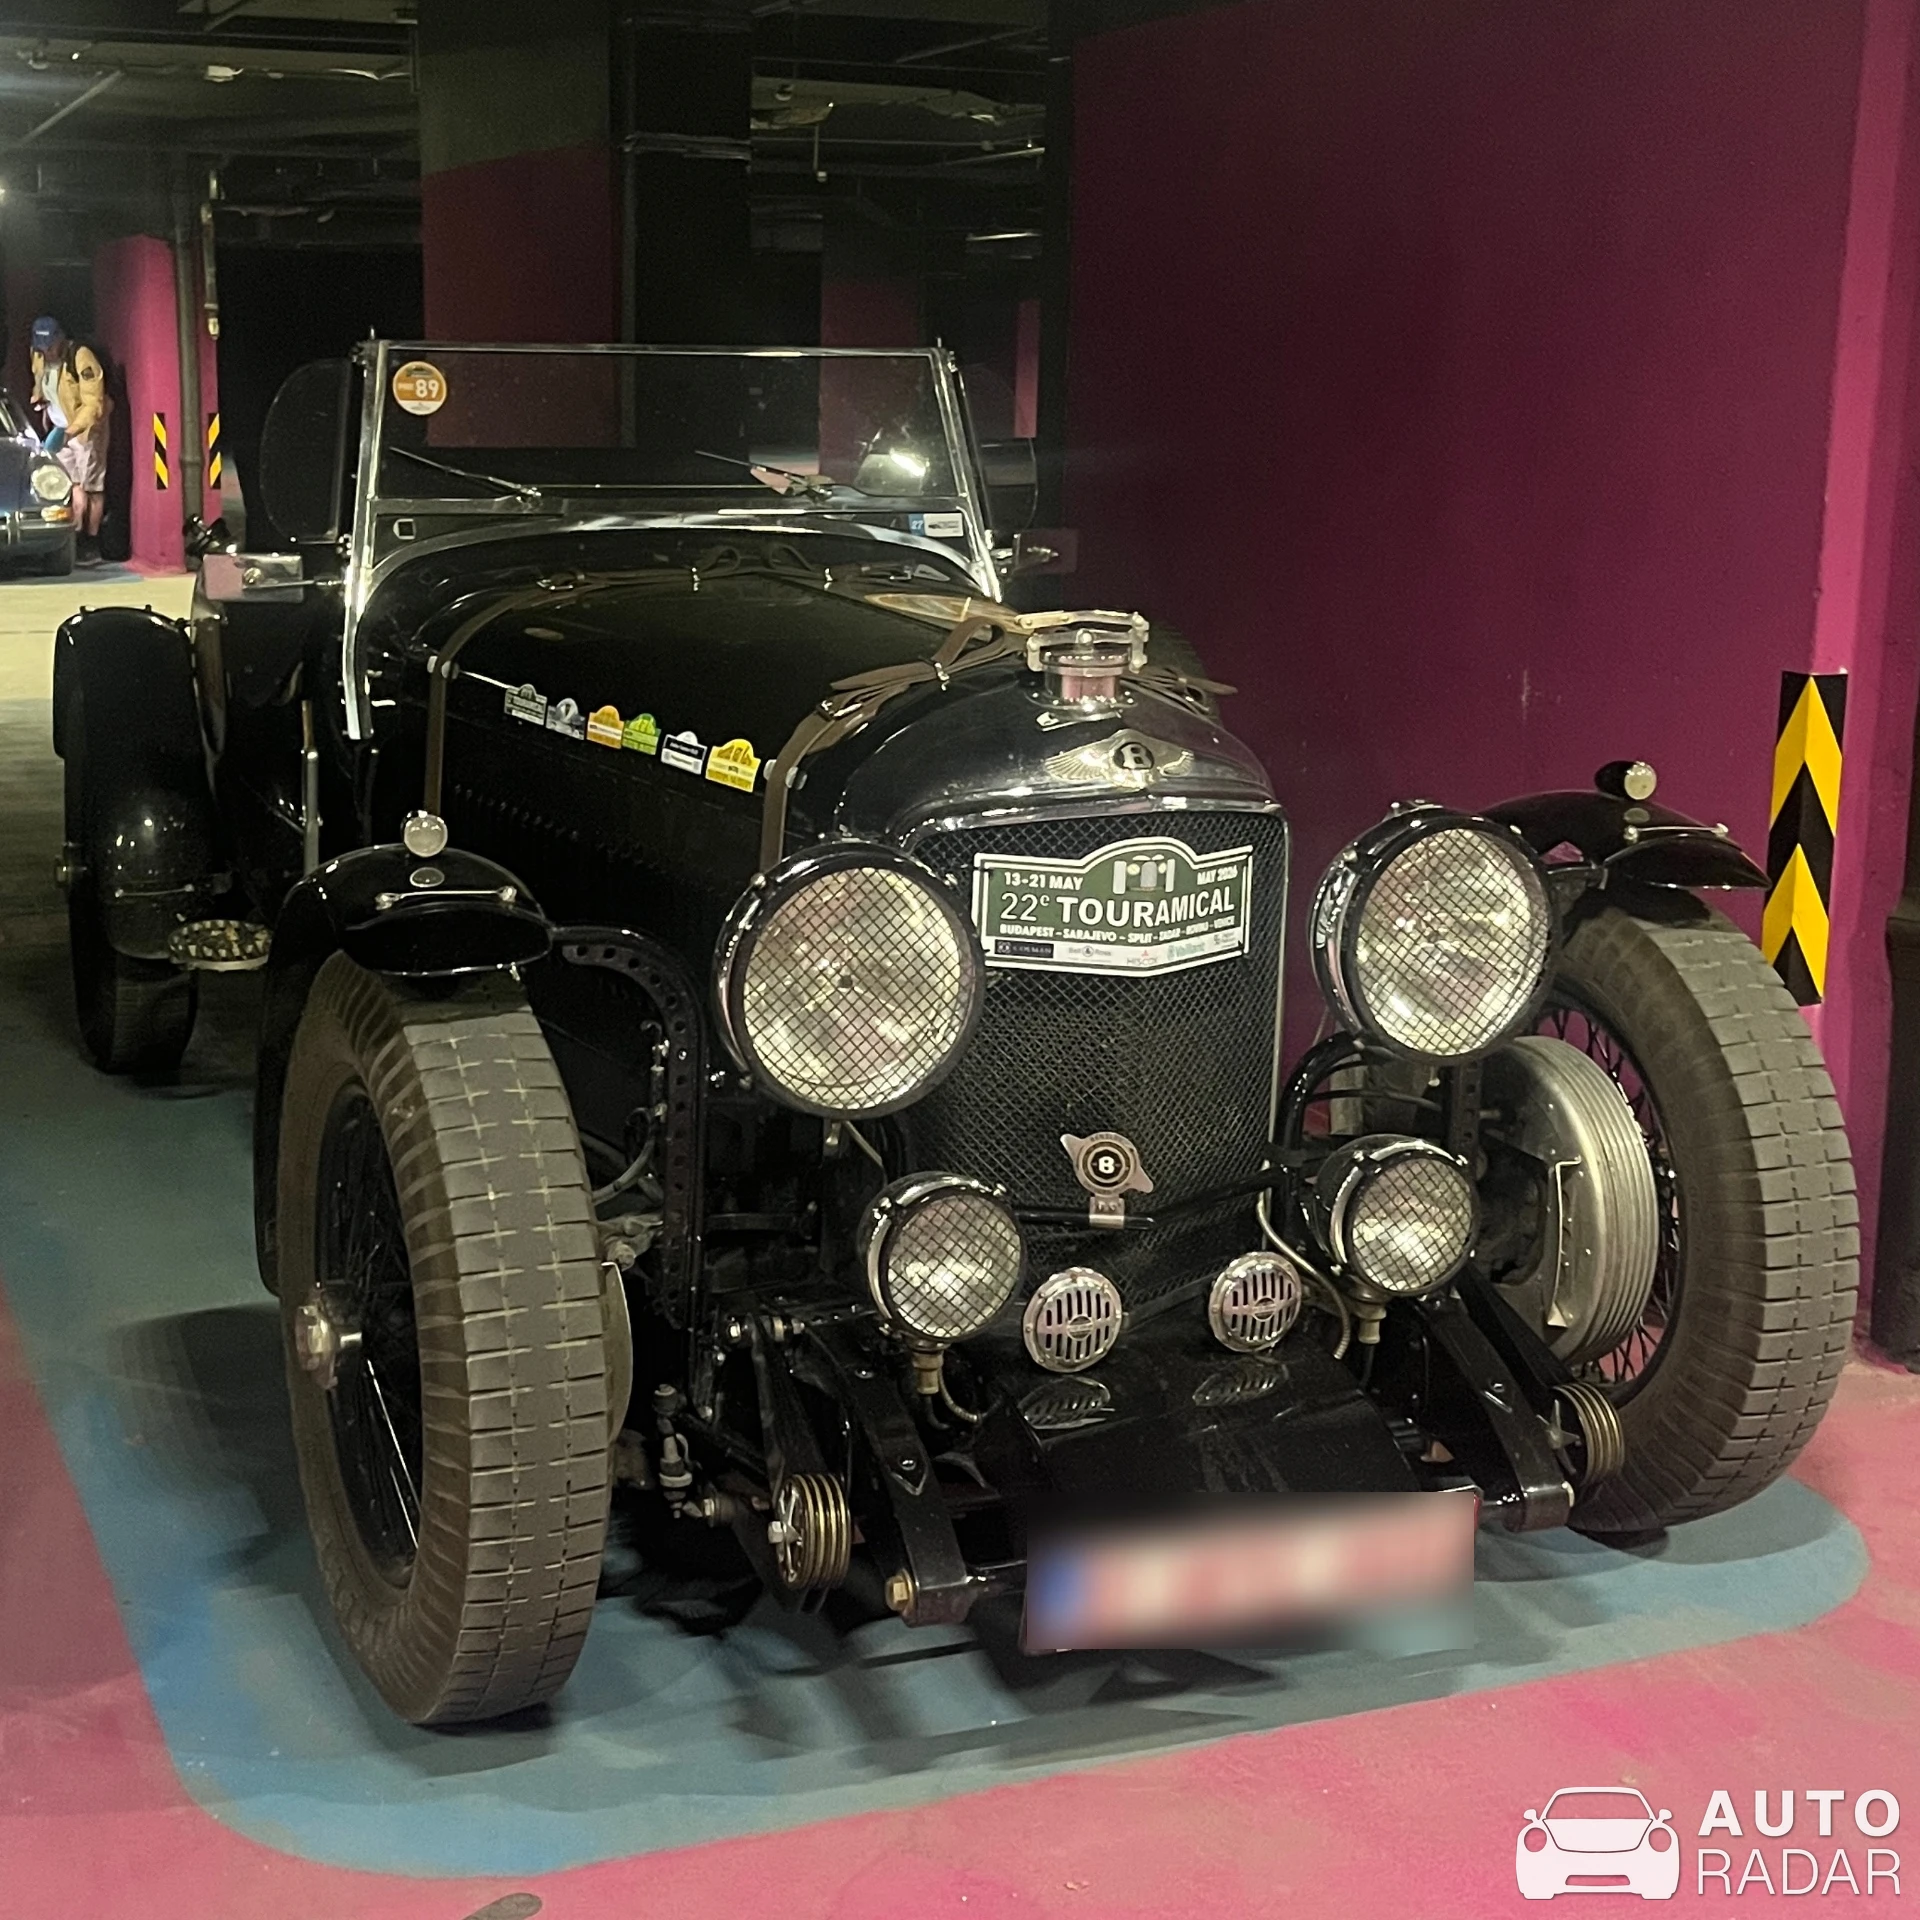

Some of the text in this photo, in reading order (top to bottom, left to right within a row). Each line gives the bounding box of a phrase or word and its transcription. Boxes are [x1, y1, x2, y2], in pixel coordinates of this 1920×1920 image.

[415, 379, 439, 398] 89
[1004, 871, 1083, 890] 13-21 MAY
[1197, 869, 1217, 885] MAY
[1056, 886, 1235, 928] TOURAMICAL
[1000, 924, 1055, 938] BUDAPEST
[1063, 928, 1117, 942] SARAJEVO
[1127, 932, 1153, 944] SPLIT
[1098, 1155, 1115, 1174] B
